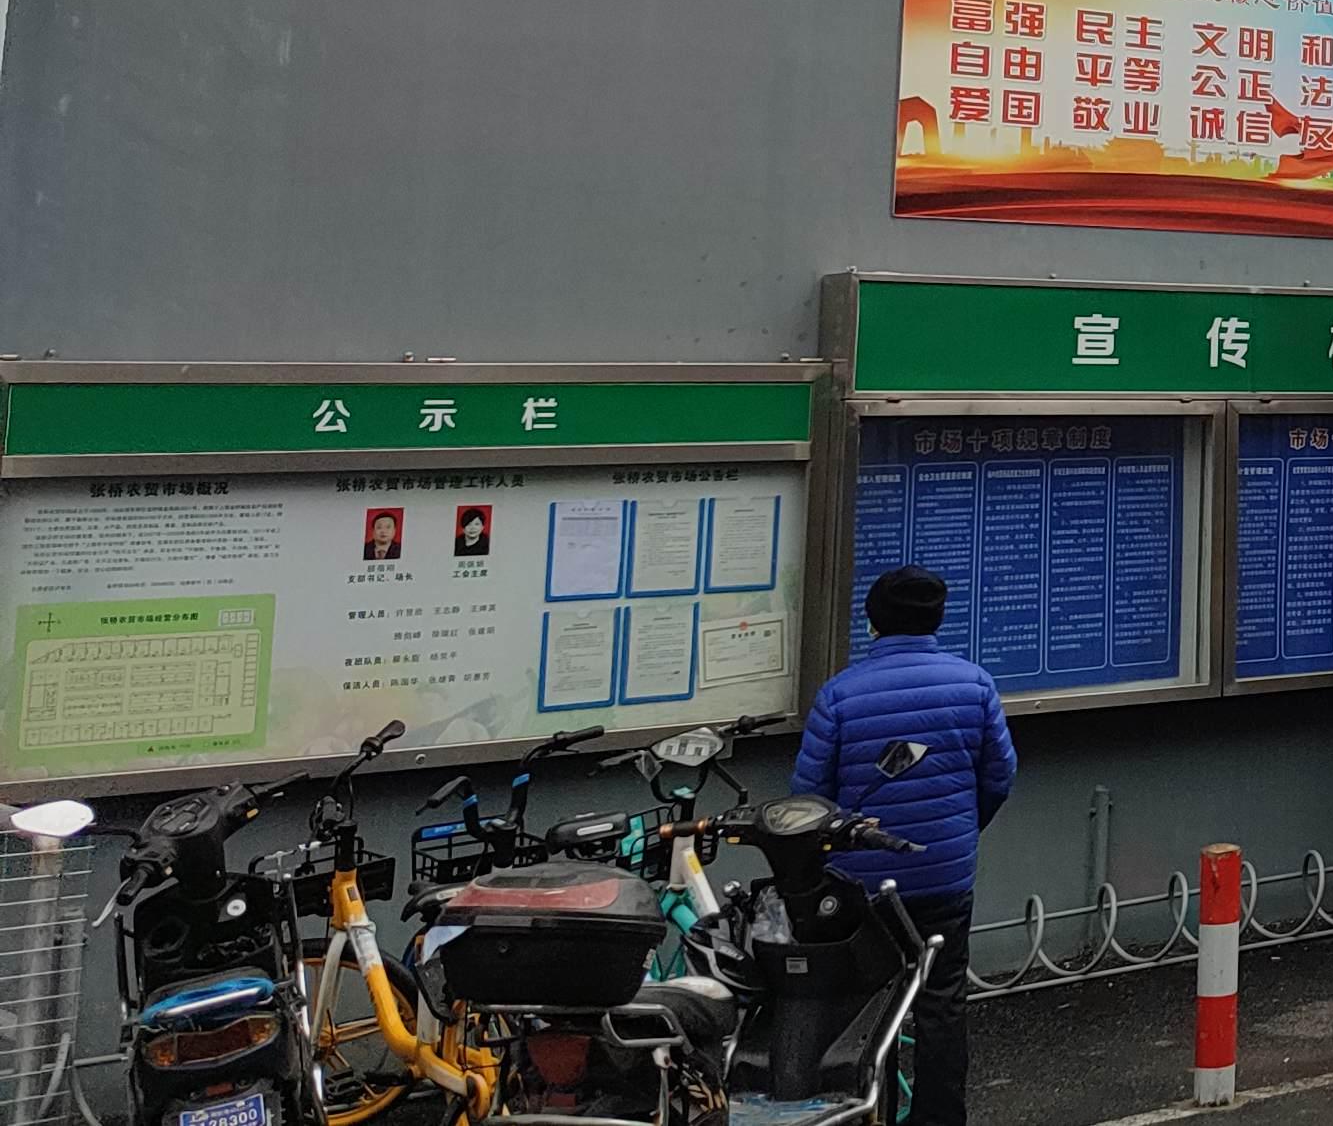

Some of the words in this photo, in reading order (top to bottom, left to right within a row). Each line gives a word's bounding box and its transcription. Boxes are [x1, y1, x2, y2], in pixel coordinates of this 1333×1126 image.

[1075, 8, 1163, 52] 民主
[1191, 22, 1274, 63] 文明
[949, 41, 1045, 83] 自由
[1074, 51, 1161, 95] 平等
[1191, 64, 1273, 105] 公正
[948, 86, 1042, 128] 爱国
[1072, 95, 1160, 139] 敬业
[1189, 106, 1272, 147] 诚信
[312, 396, 560, 434] 公示栏
[914, 426, 1112, 455] 市场十项规章制度
[90, 481, 229, 499] 张桥农贸市场概况
[336, 474, 525, 493] 张桥农贸市场管理工作人员
